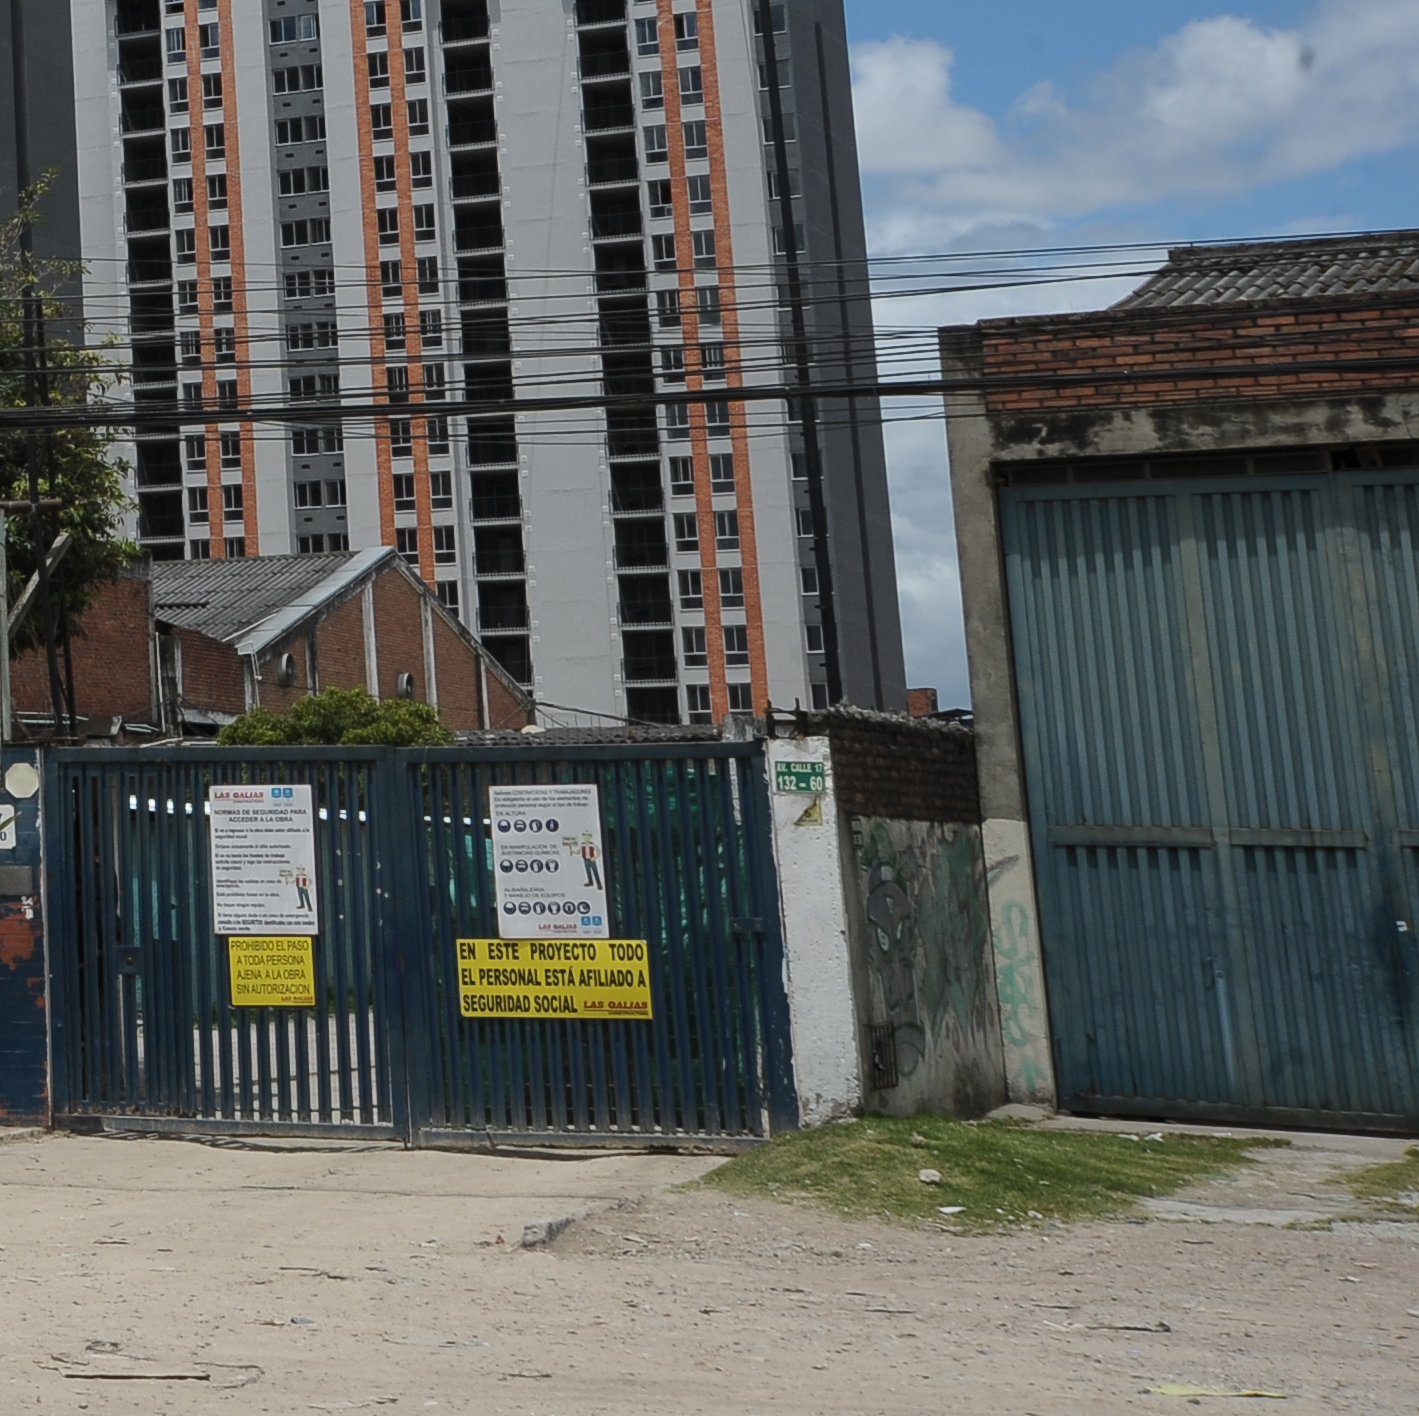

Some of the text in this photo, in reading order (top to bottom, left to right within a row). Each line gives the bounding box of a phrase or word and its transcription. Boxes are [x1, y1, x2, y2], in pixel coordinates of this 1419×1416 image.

[777, 763, 823, 773] AV. CALLE 17
[778, 775, 797, 791] 132
[810, 775, 823, 791] 60
[231, 940, 309, 951] PROHIBIDO EL PASO
[459, 942, 644, 962] EN ESTE PROYECTO TODO
[237, 955, 305, 966] A TODA PERSONA
[237, 969, 306, 980] AJENA A LA OBRA
[462, 966, 646, 988] EL PERSONAL ESTÁ AFILIADO A
[237, 983, 250, 995] SIN
[463, 994, 530, 1013] SEGURIDAD
[534, 995, 578, 1013] SOCIAL
[608, 1001, 648, 1009] GALIAS
